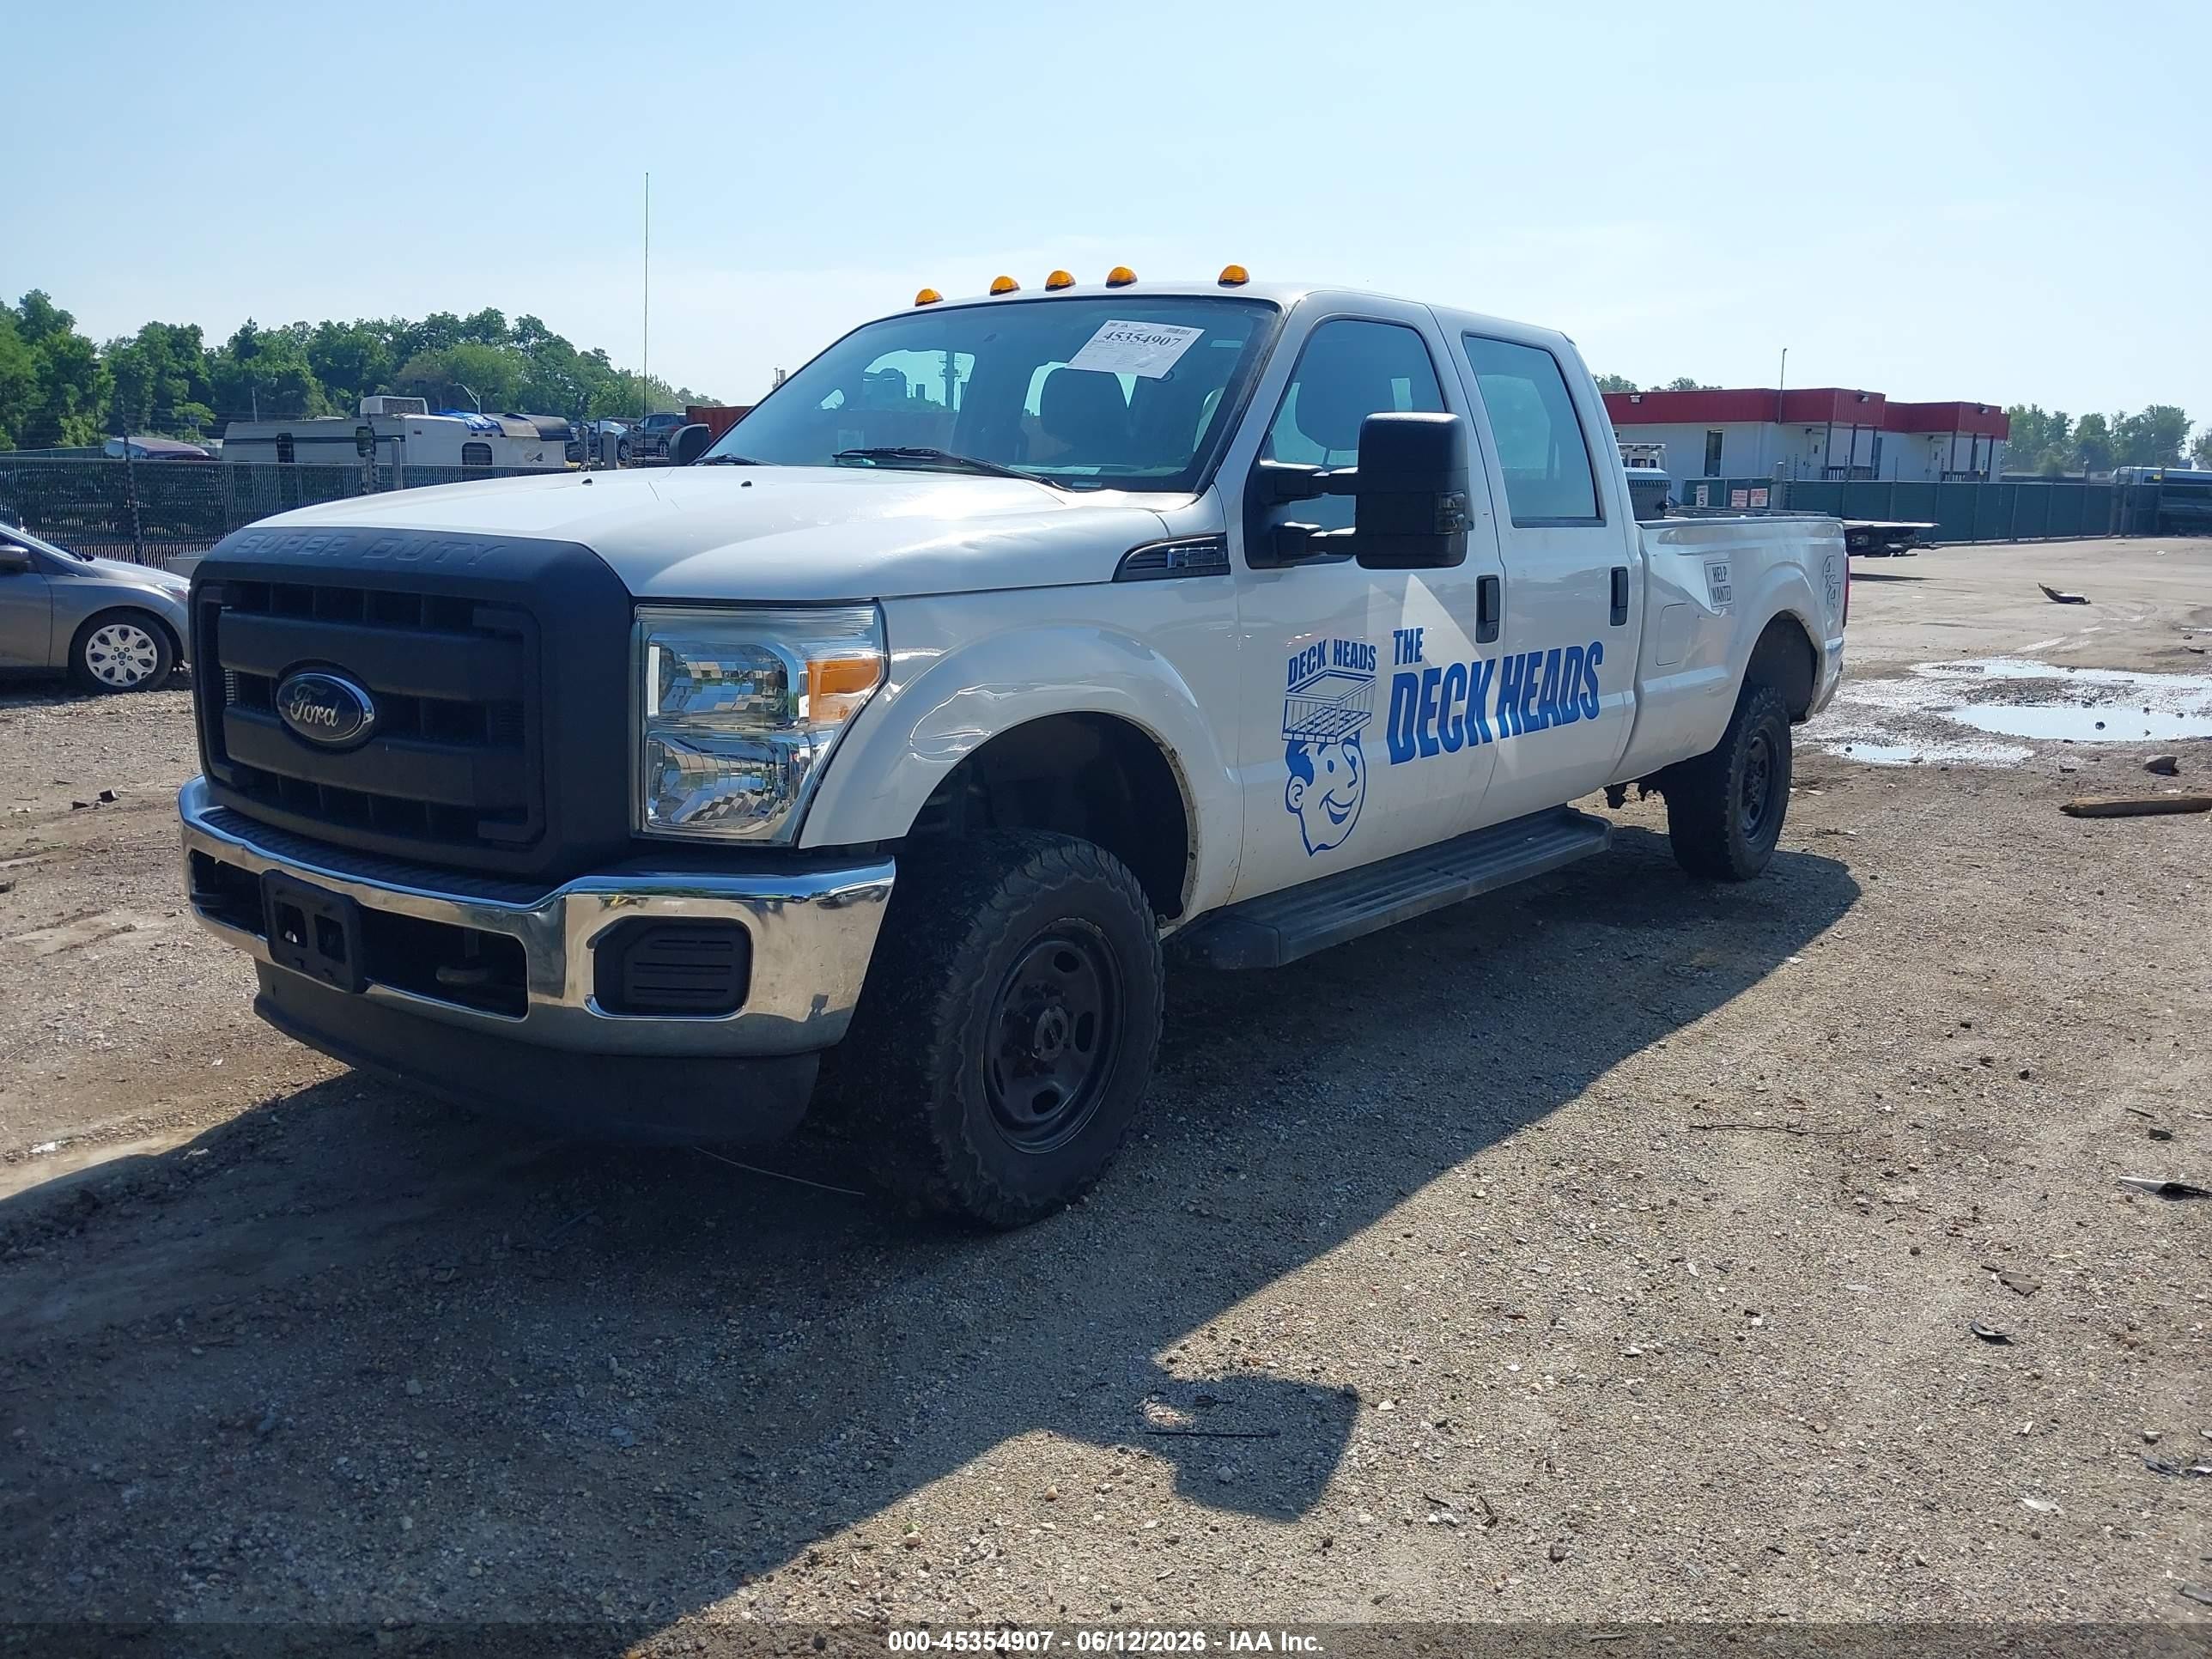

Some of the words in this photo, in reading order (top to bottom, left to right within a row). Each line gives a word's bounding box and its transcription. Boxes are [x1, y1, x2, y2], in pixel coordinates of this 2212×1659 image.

[1103, 331, 1182, 347] 45354907
[235, 534, 355, 556] SUPER
[362, 538, 507, 565] DUTY
[1711, 566, 1728, 583] HELP
[1288, 639, 1327, 686] DECK
[1334, 638, 1376, 672] HEADS
[1393, 627, 1424, 666] THE
[289, 683, 339, 728] Ford
[1387, 659, 1497, 764] DECK
[1497, 641, 1604, 738] HEADS
